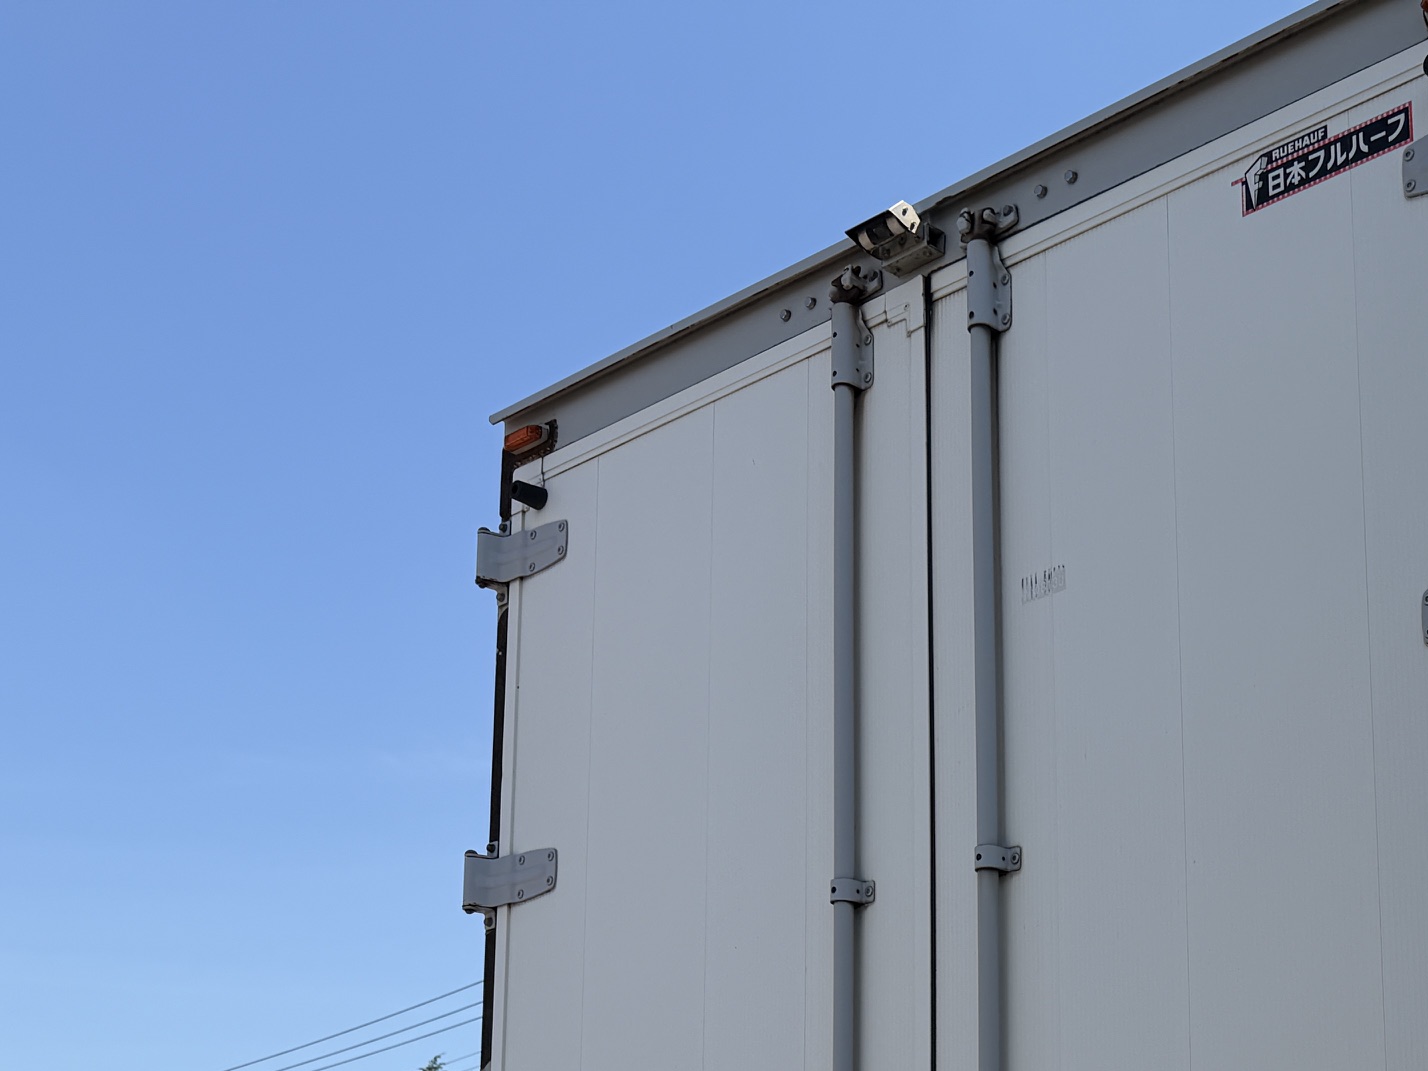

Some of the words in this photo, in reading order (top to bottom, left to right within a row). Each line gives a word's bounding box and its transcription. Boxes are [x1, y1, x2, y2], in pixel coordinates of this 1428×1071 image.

[1268, 113, 1405, 197] 日本フルハーフ
